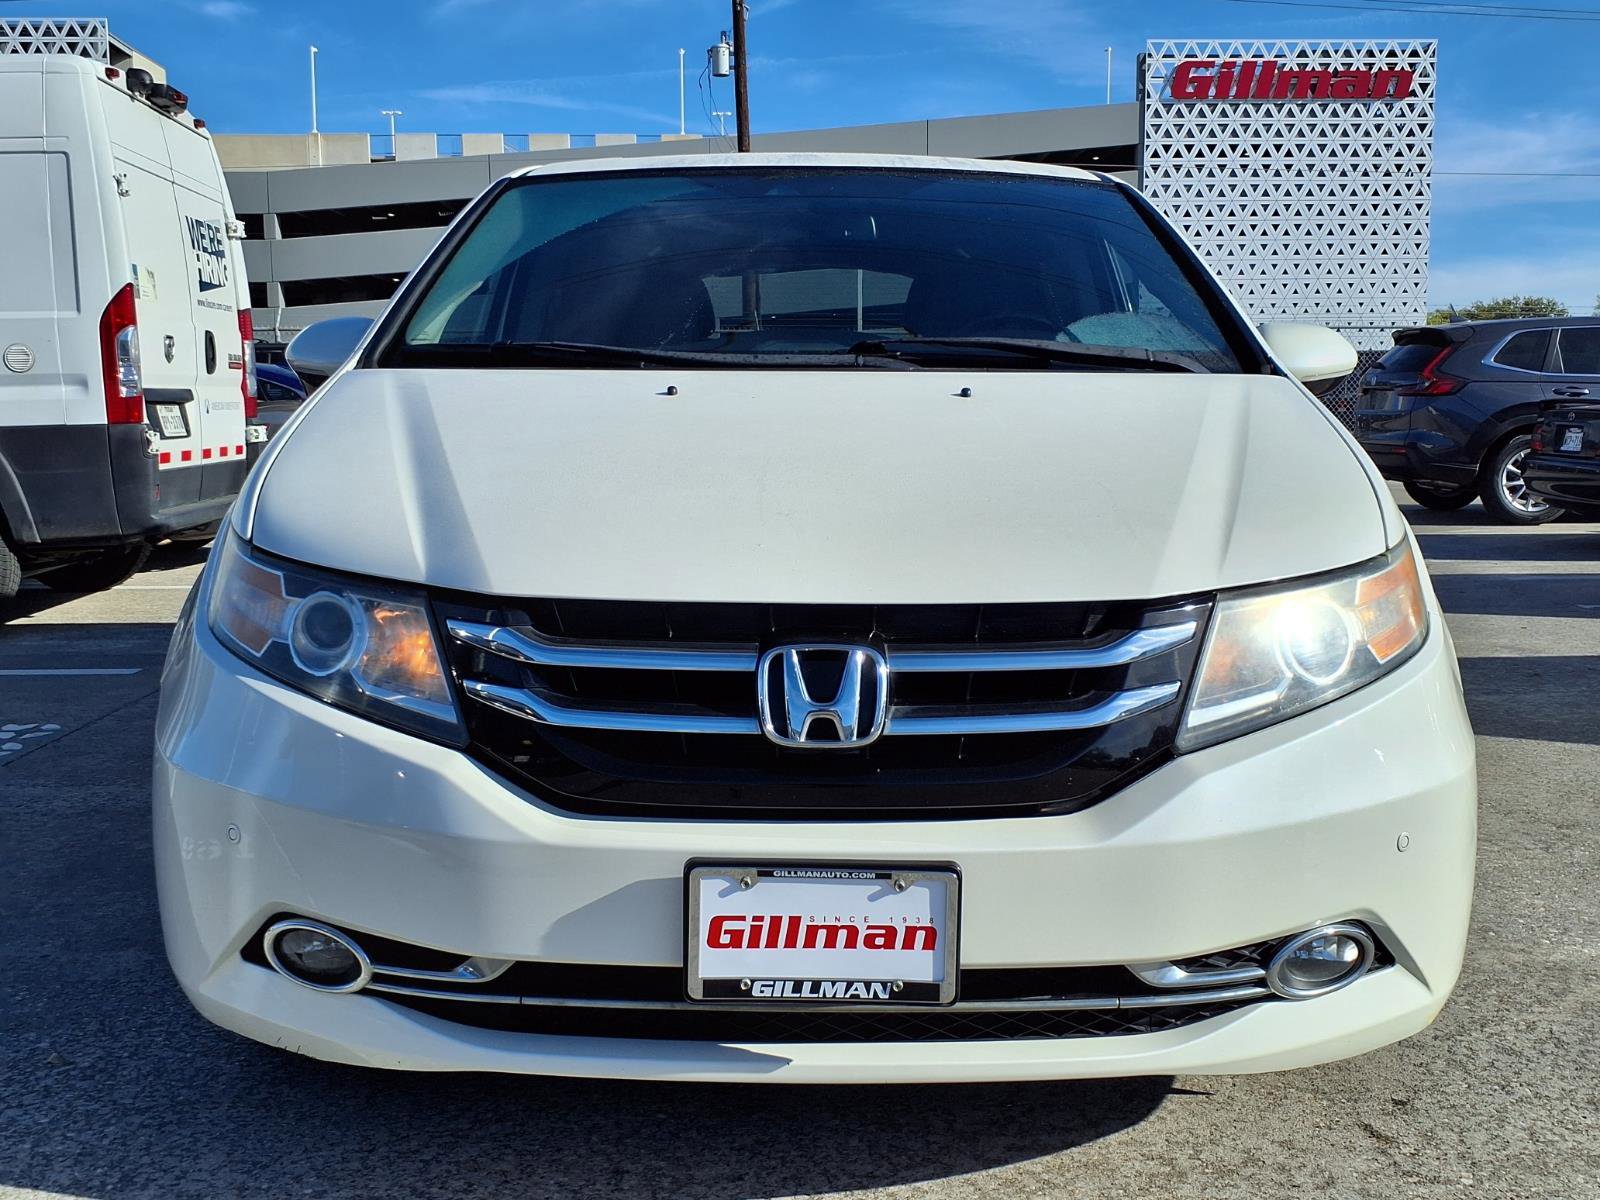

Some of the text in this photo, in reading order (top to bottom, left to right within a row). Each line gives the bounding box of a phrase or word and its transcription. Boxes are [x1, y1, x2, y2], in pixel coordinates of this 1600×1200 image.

[1170, 60, 1414, 100] Gillman
[185, 215, 223, 253] WE'RE
[194, 250, 229, 287] HIRING
[773, 869, 876, 880] GILLMANAUTO.COM
[706, 915, 938, 951] Gillman
[809, 915, 935, 925] SINCE 1938
[751, 980, 893, 1000] GILLMAN
